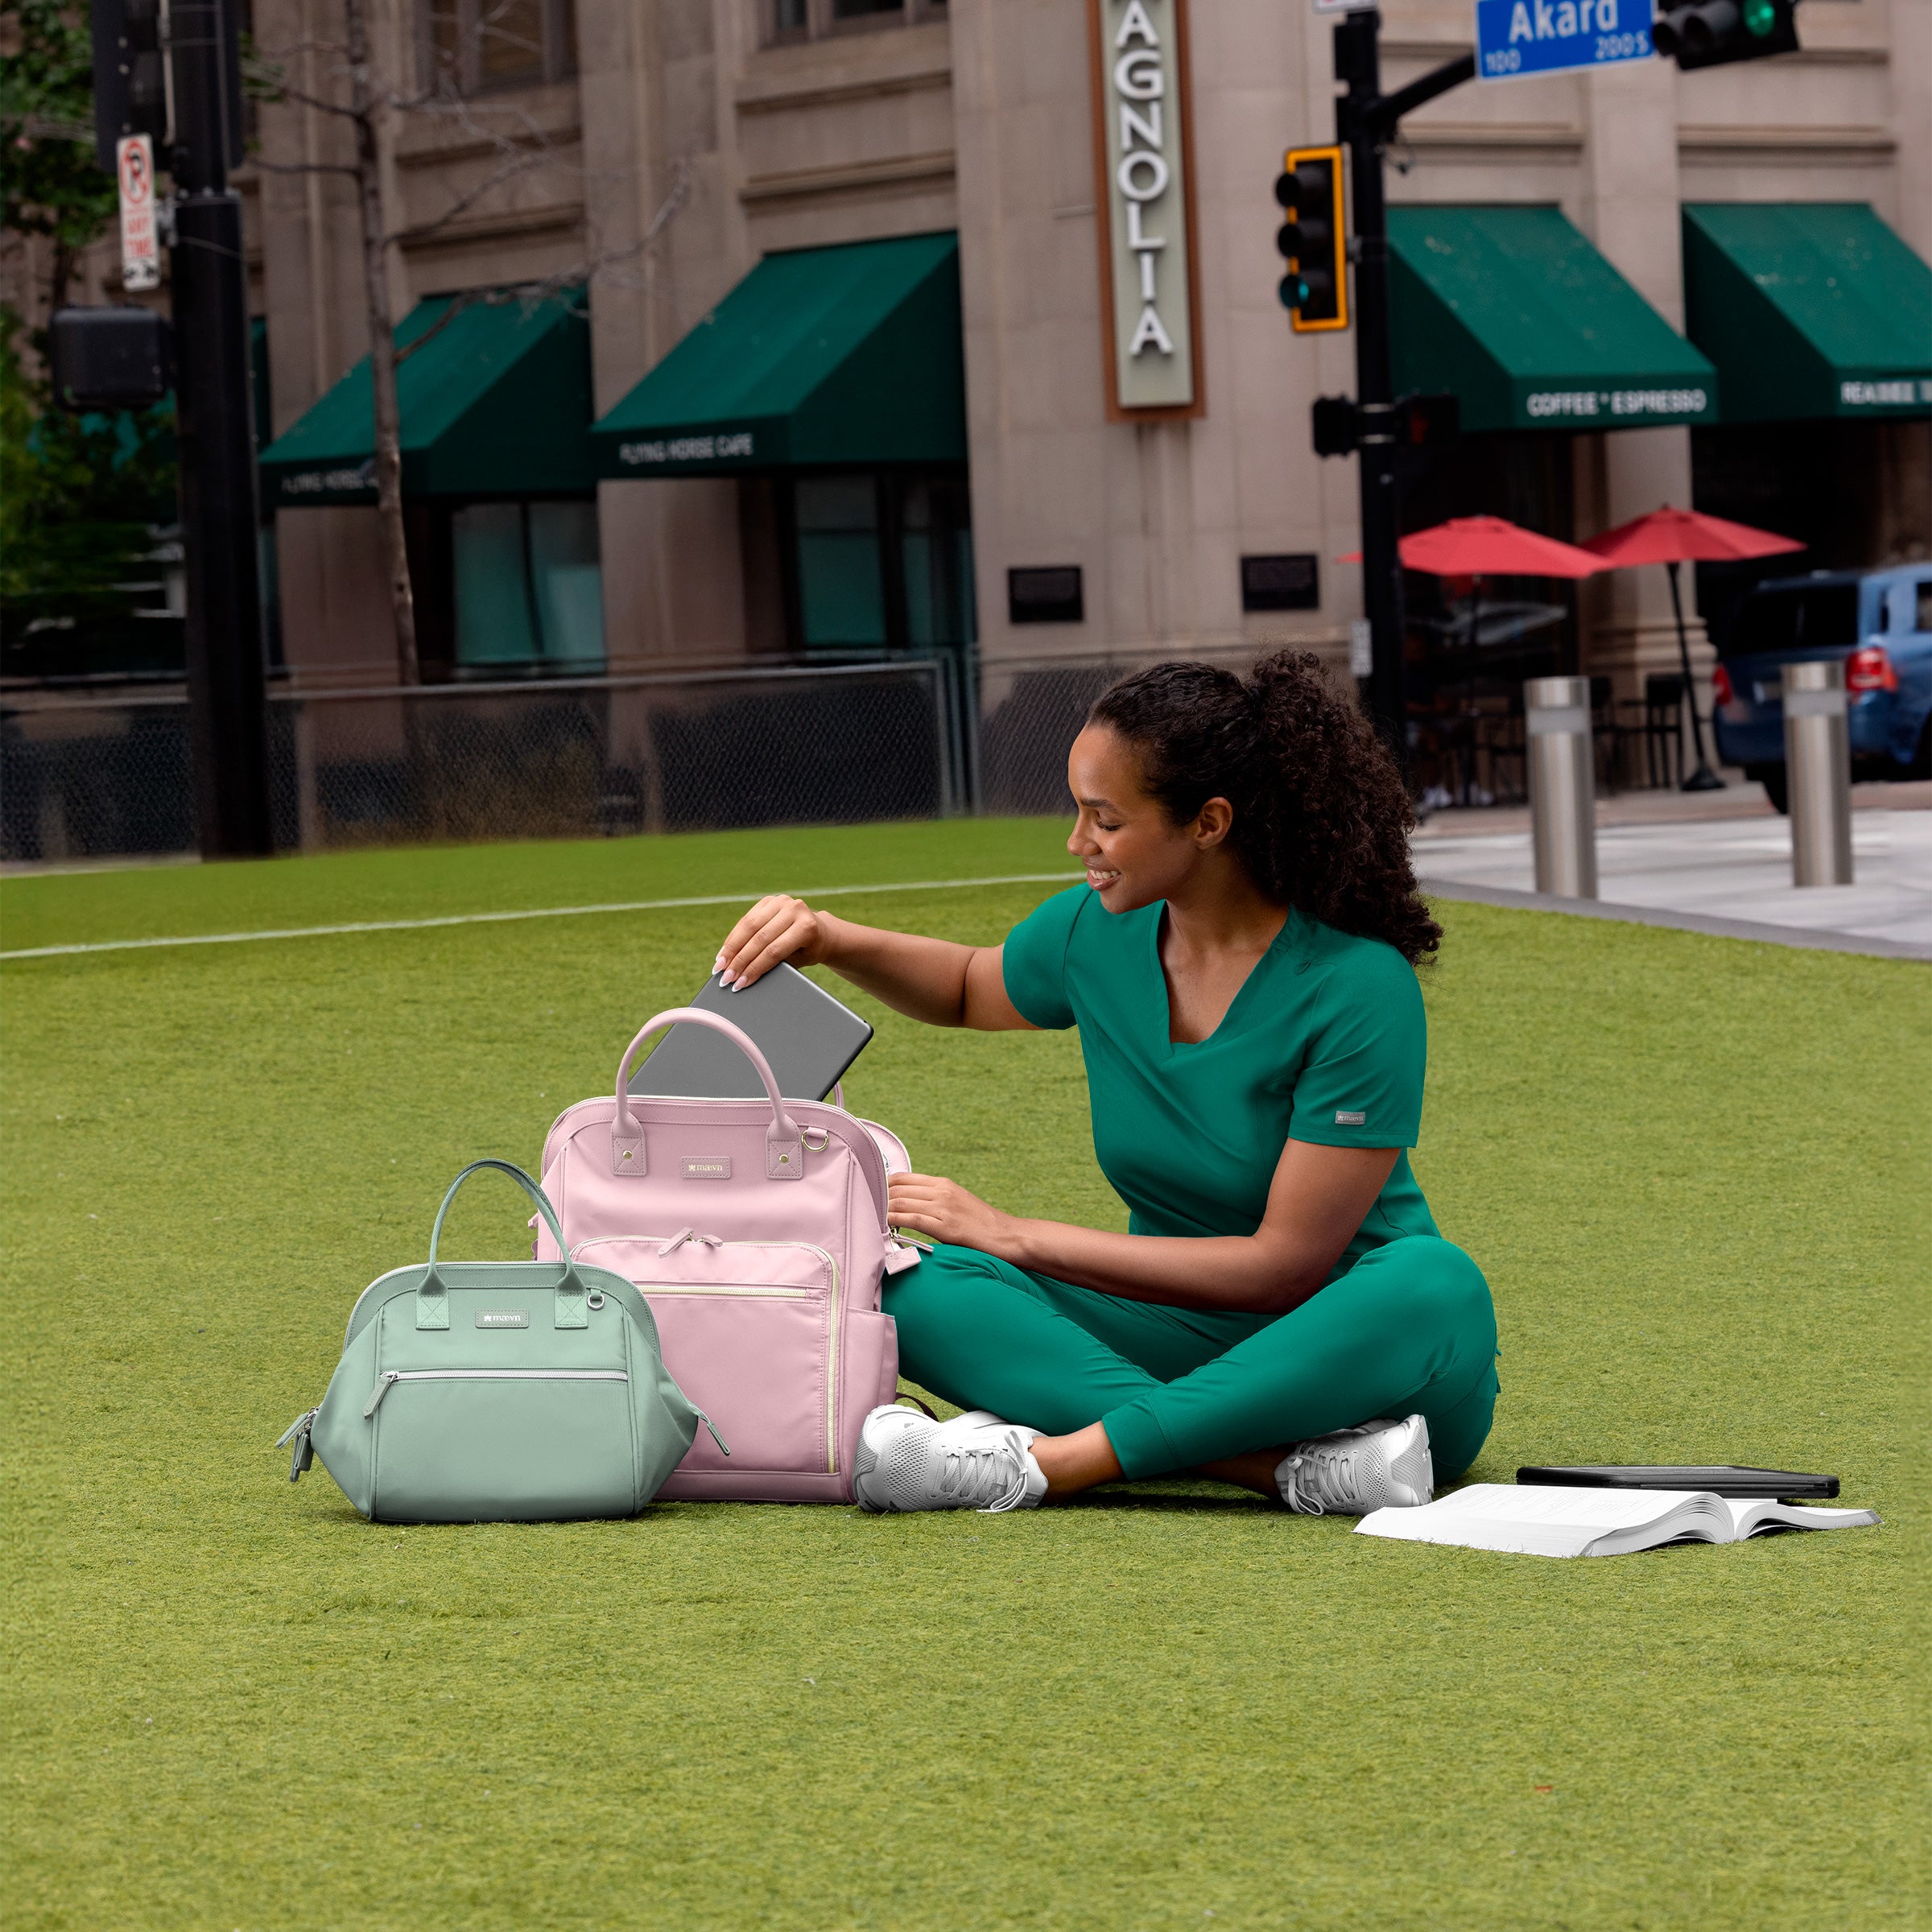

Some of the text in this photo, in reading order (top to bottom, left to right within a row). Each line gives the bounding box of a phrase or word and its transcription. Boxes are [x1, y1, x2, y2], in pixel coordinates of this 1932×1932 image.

[1509, 0, 1619, 43] Akard
[1113, 0, 1174, 357] AGNOLIA
[1526, 388, 1707, 417] COFFEE ESPRESSO
